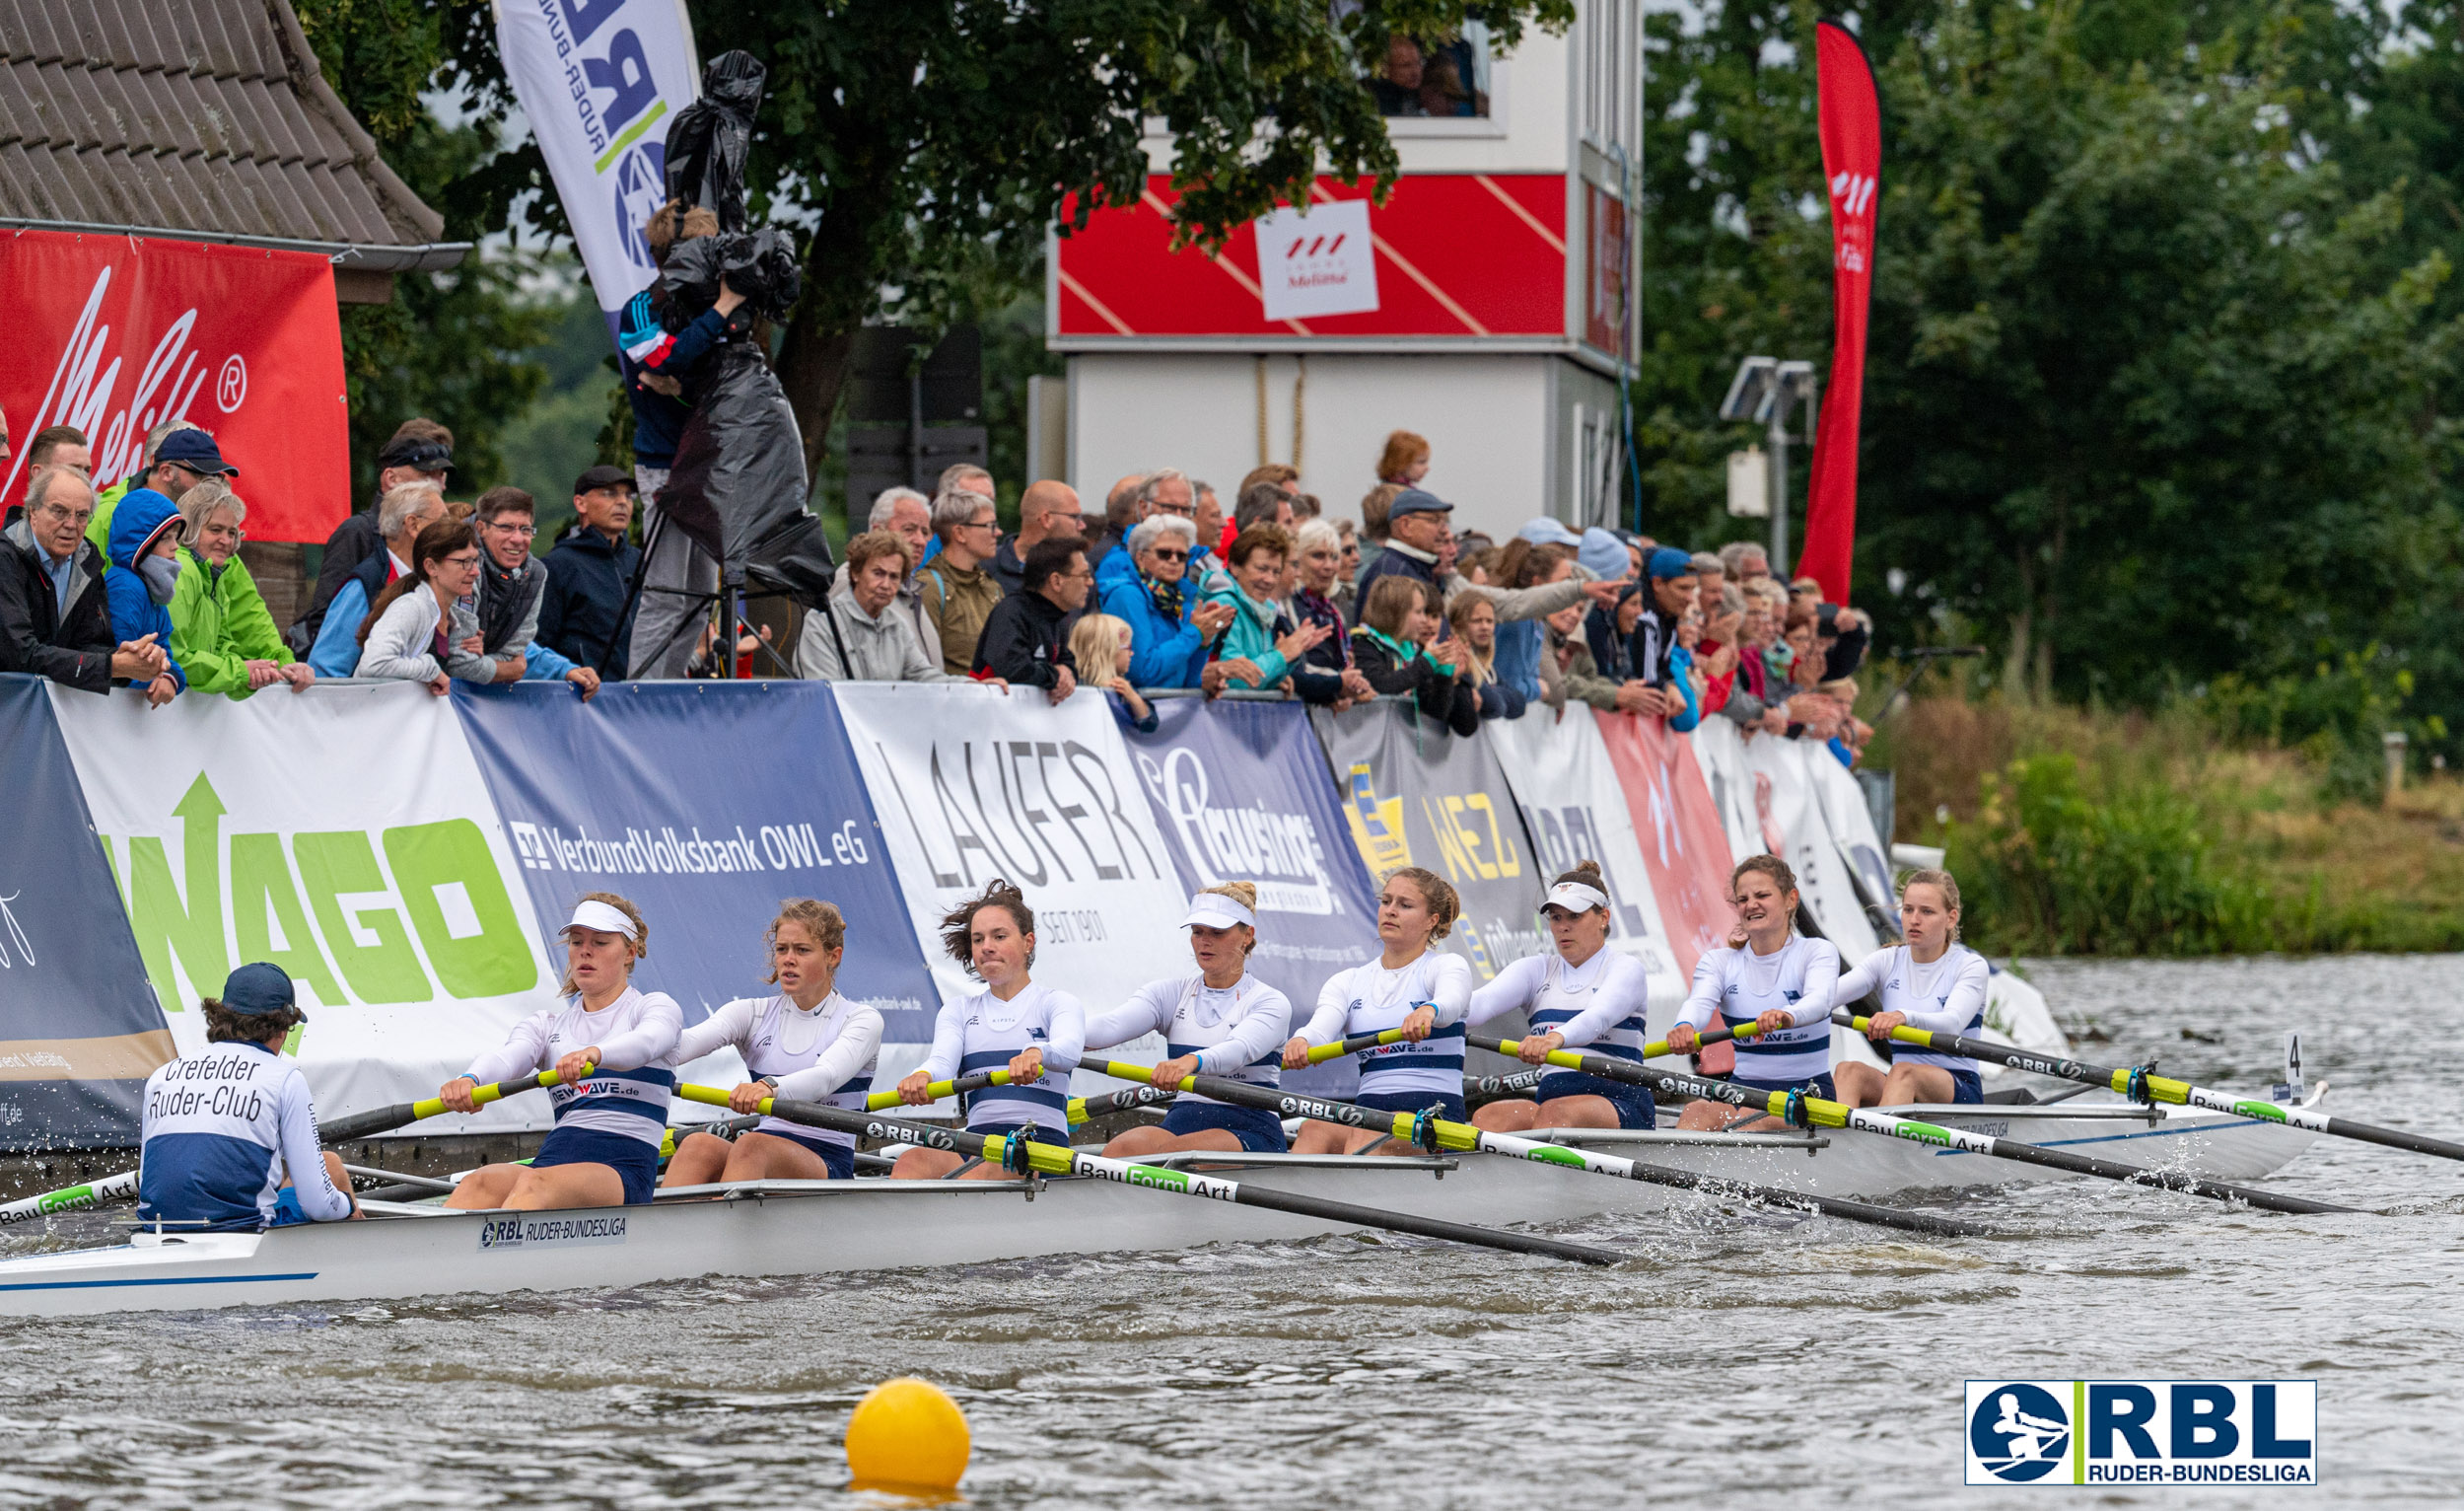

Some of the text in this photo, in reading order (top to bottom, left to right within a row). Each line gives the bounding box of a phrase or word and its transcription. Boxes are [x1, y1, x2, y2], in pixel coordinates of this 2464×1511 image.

[876, 740, 1162, 888] LAUFER
[542, 820, 870, 874] VerbundVolksbank OWL eG
[1421, 792, 1521, 884] WEZ
[101, 769, 539, 1014] WAGO
[1041, 909, 1108, 944] SEIT 1901
[165, 1054, 260, 1081] Crefelder
[2022, 1057, 2056, 1076] RBL
[2289, 1035, 2300, 1078] 4
[149, 1085, 261, 1122] Ruder-Club
[1677, 1080, 1712, 1099] RBL
[1299, 1099, 1335, 1119] RBL
[885, 1125, 925, 1146] RBL
[1080, 1161, 1231, 1201] Bau Form Art
[0, 1206, 39, 1226] Bau
[101, 1181, 132, 1201] Art
[495, 1217, 627, 1242] RBL RUDER-BUNDESLIGA
